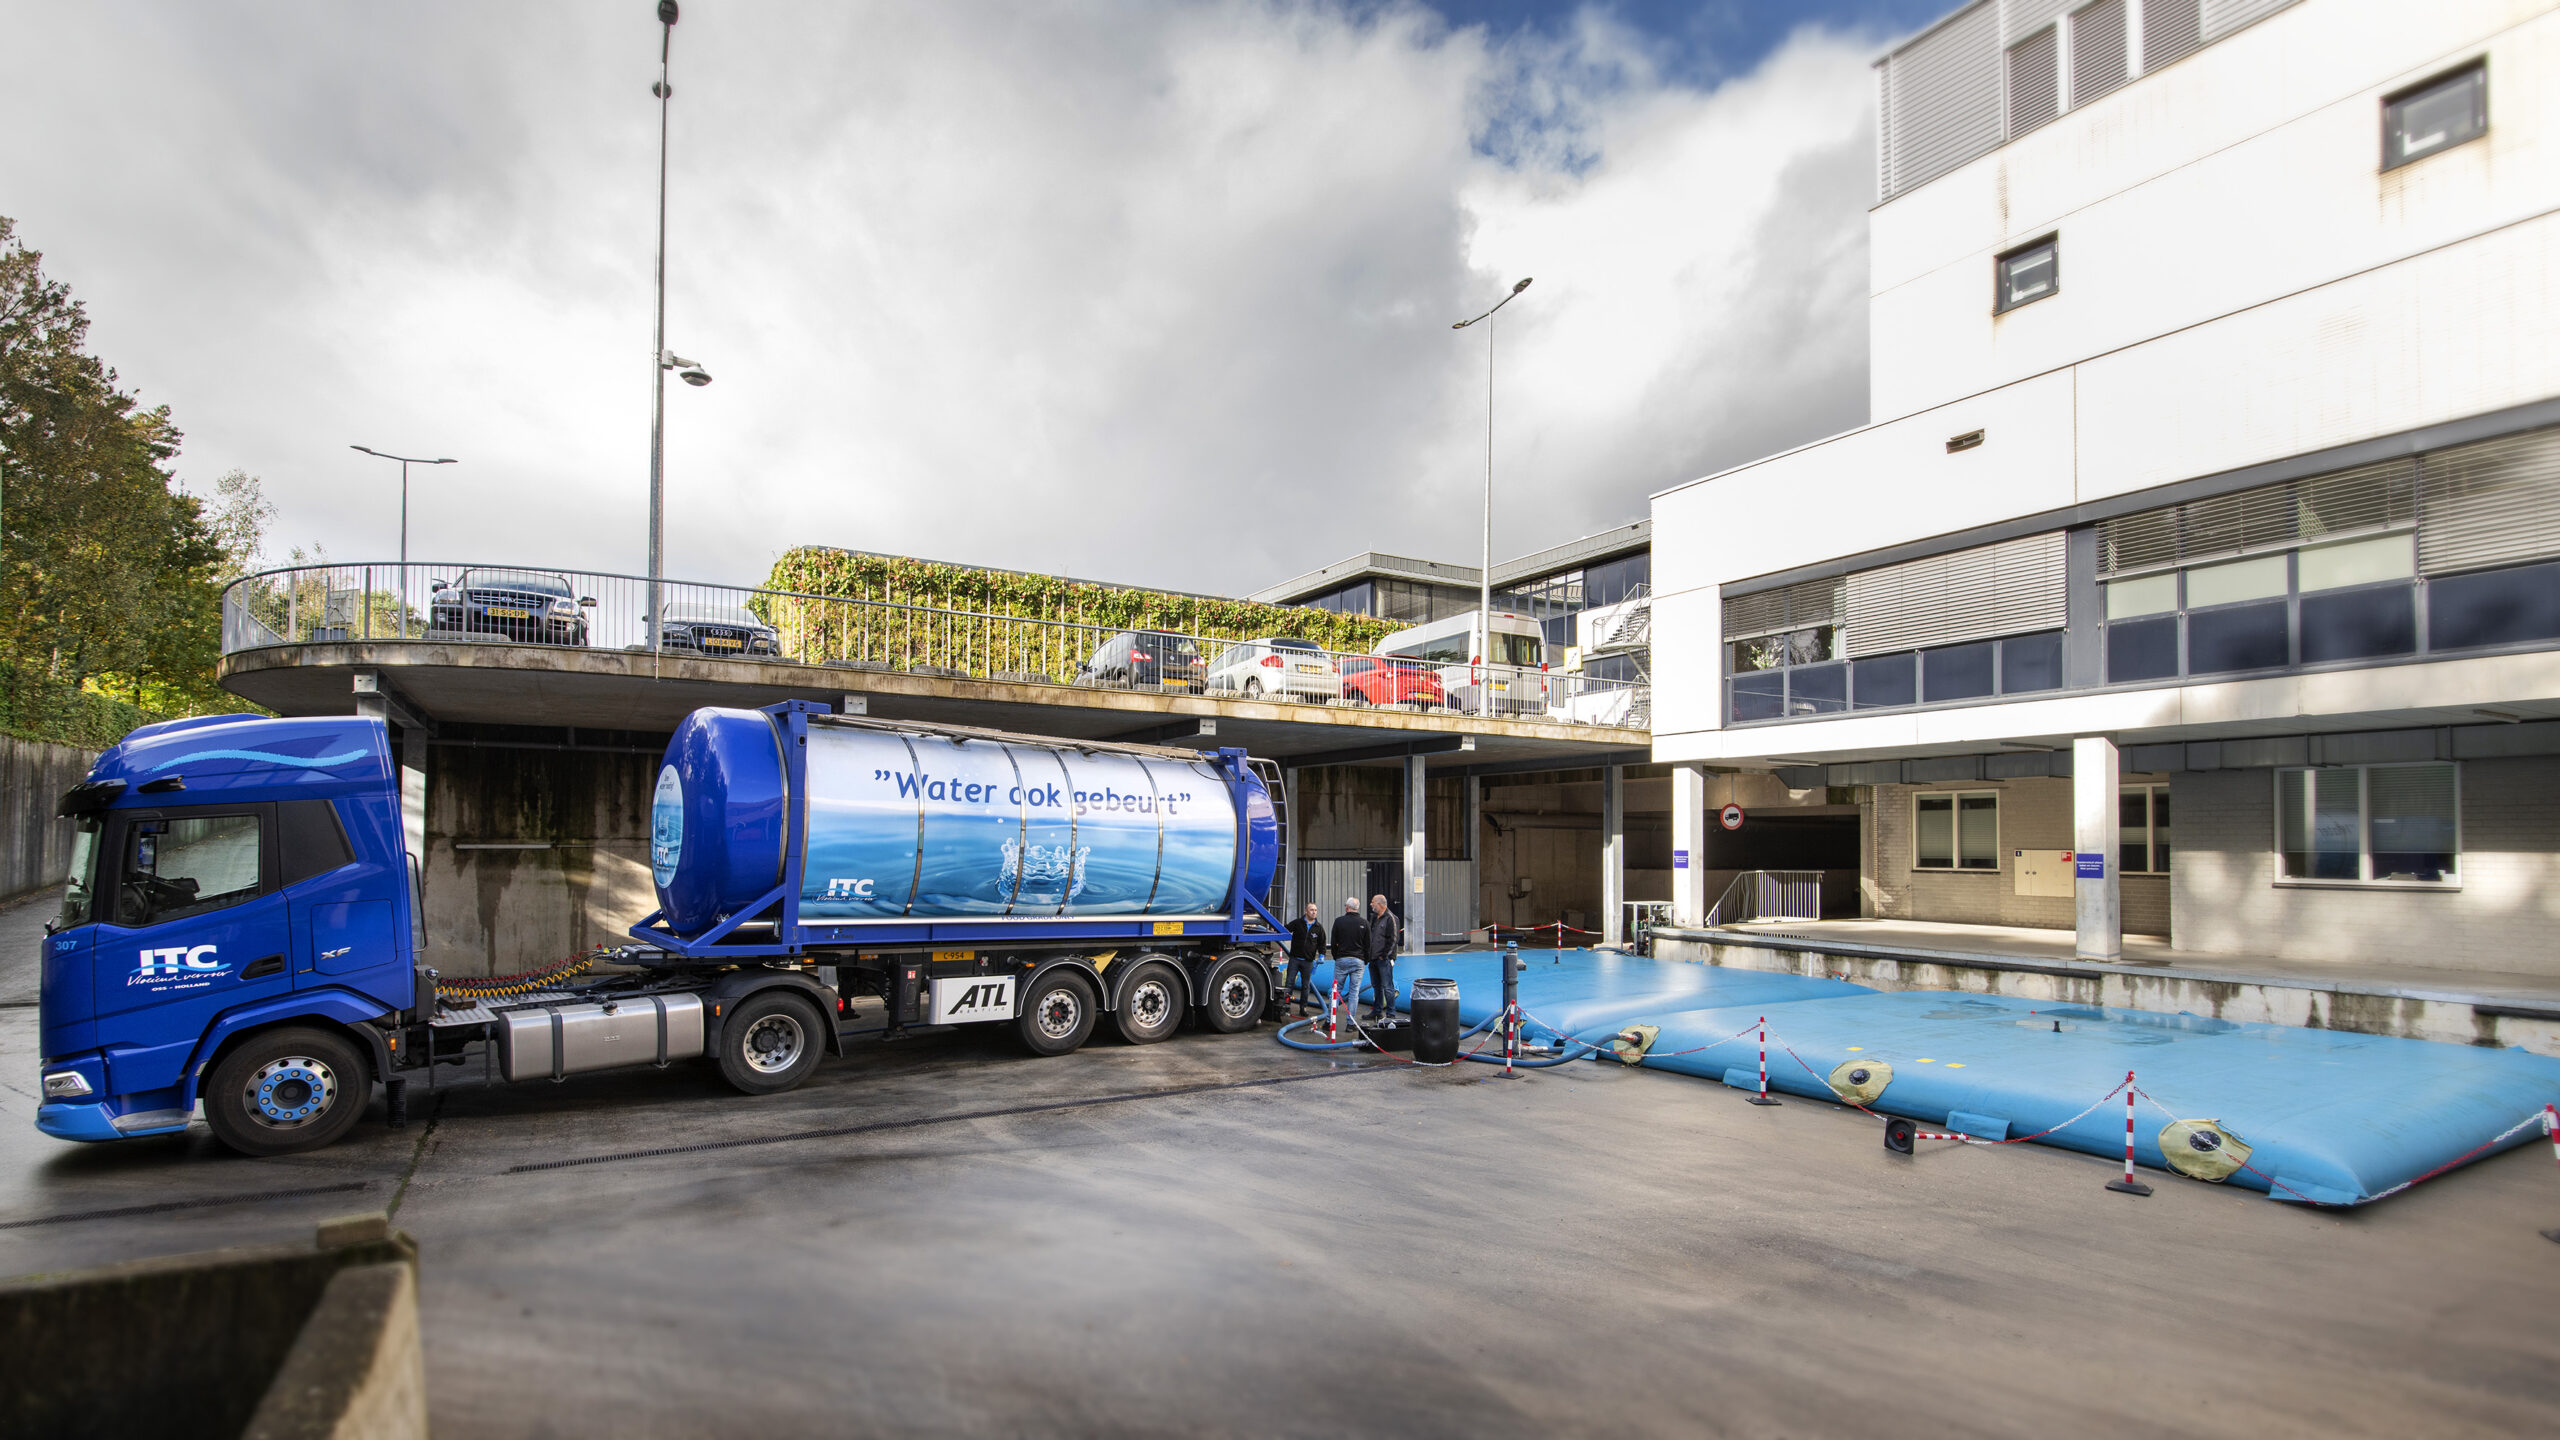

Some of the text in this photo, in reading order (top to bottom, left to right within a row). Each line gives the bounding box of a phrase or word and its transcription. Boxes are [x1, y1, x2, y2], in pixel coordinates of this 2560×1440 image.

[490, 608, 526, 617] 31SG-DP
[1009, 783, 1062, 807] ook
[827, 878, 875, 897] ITC
[55, 940, 77, 951] 307
[140, 944, 218, 976] ITC
[320, 946, 352, 960] XF
[943, 952, 964, 960] C-954
[174, 982, 211, 990] HOLLAND
[947, 983, 1008, 1015] ATL
